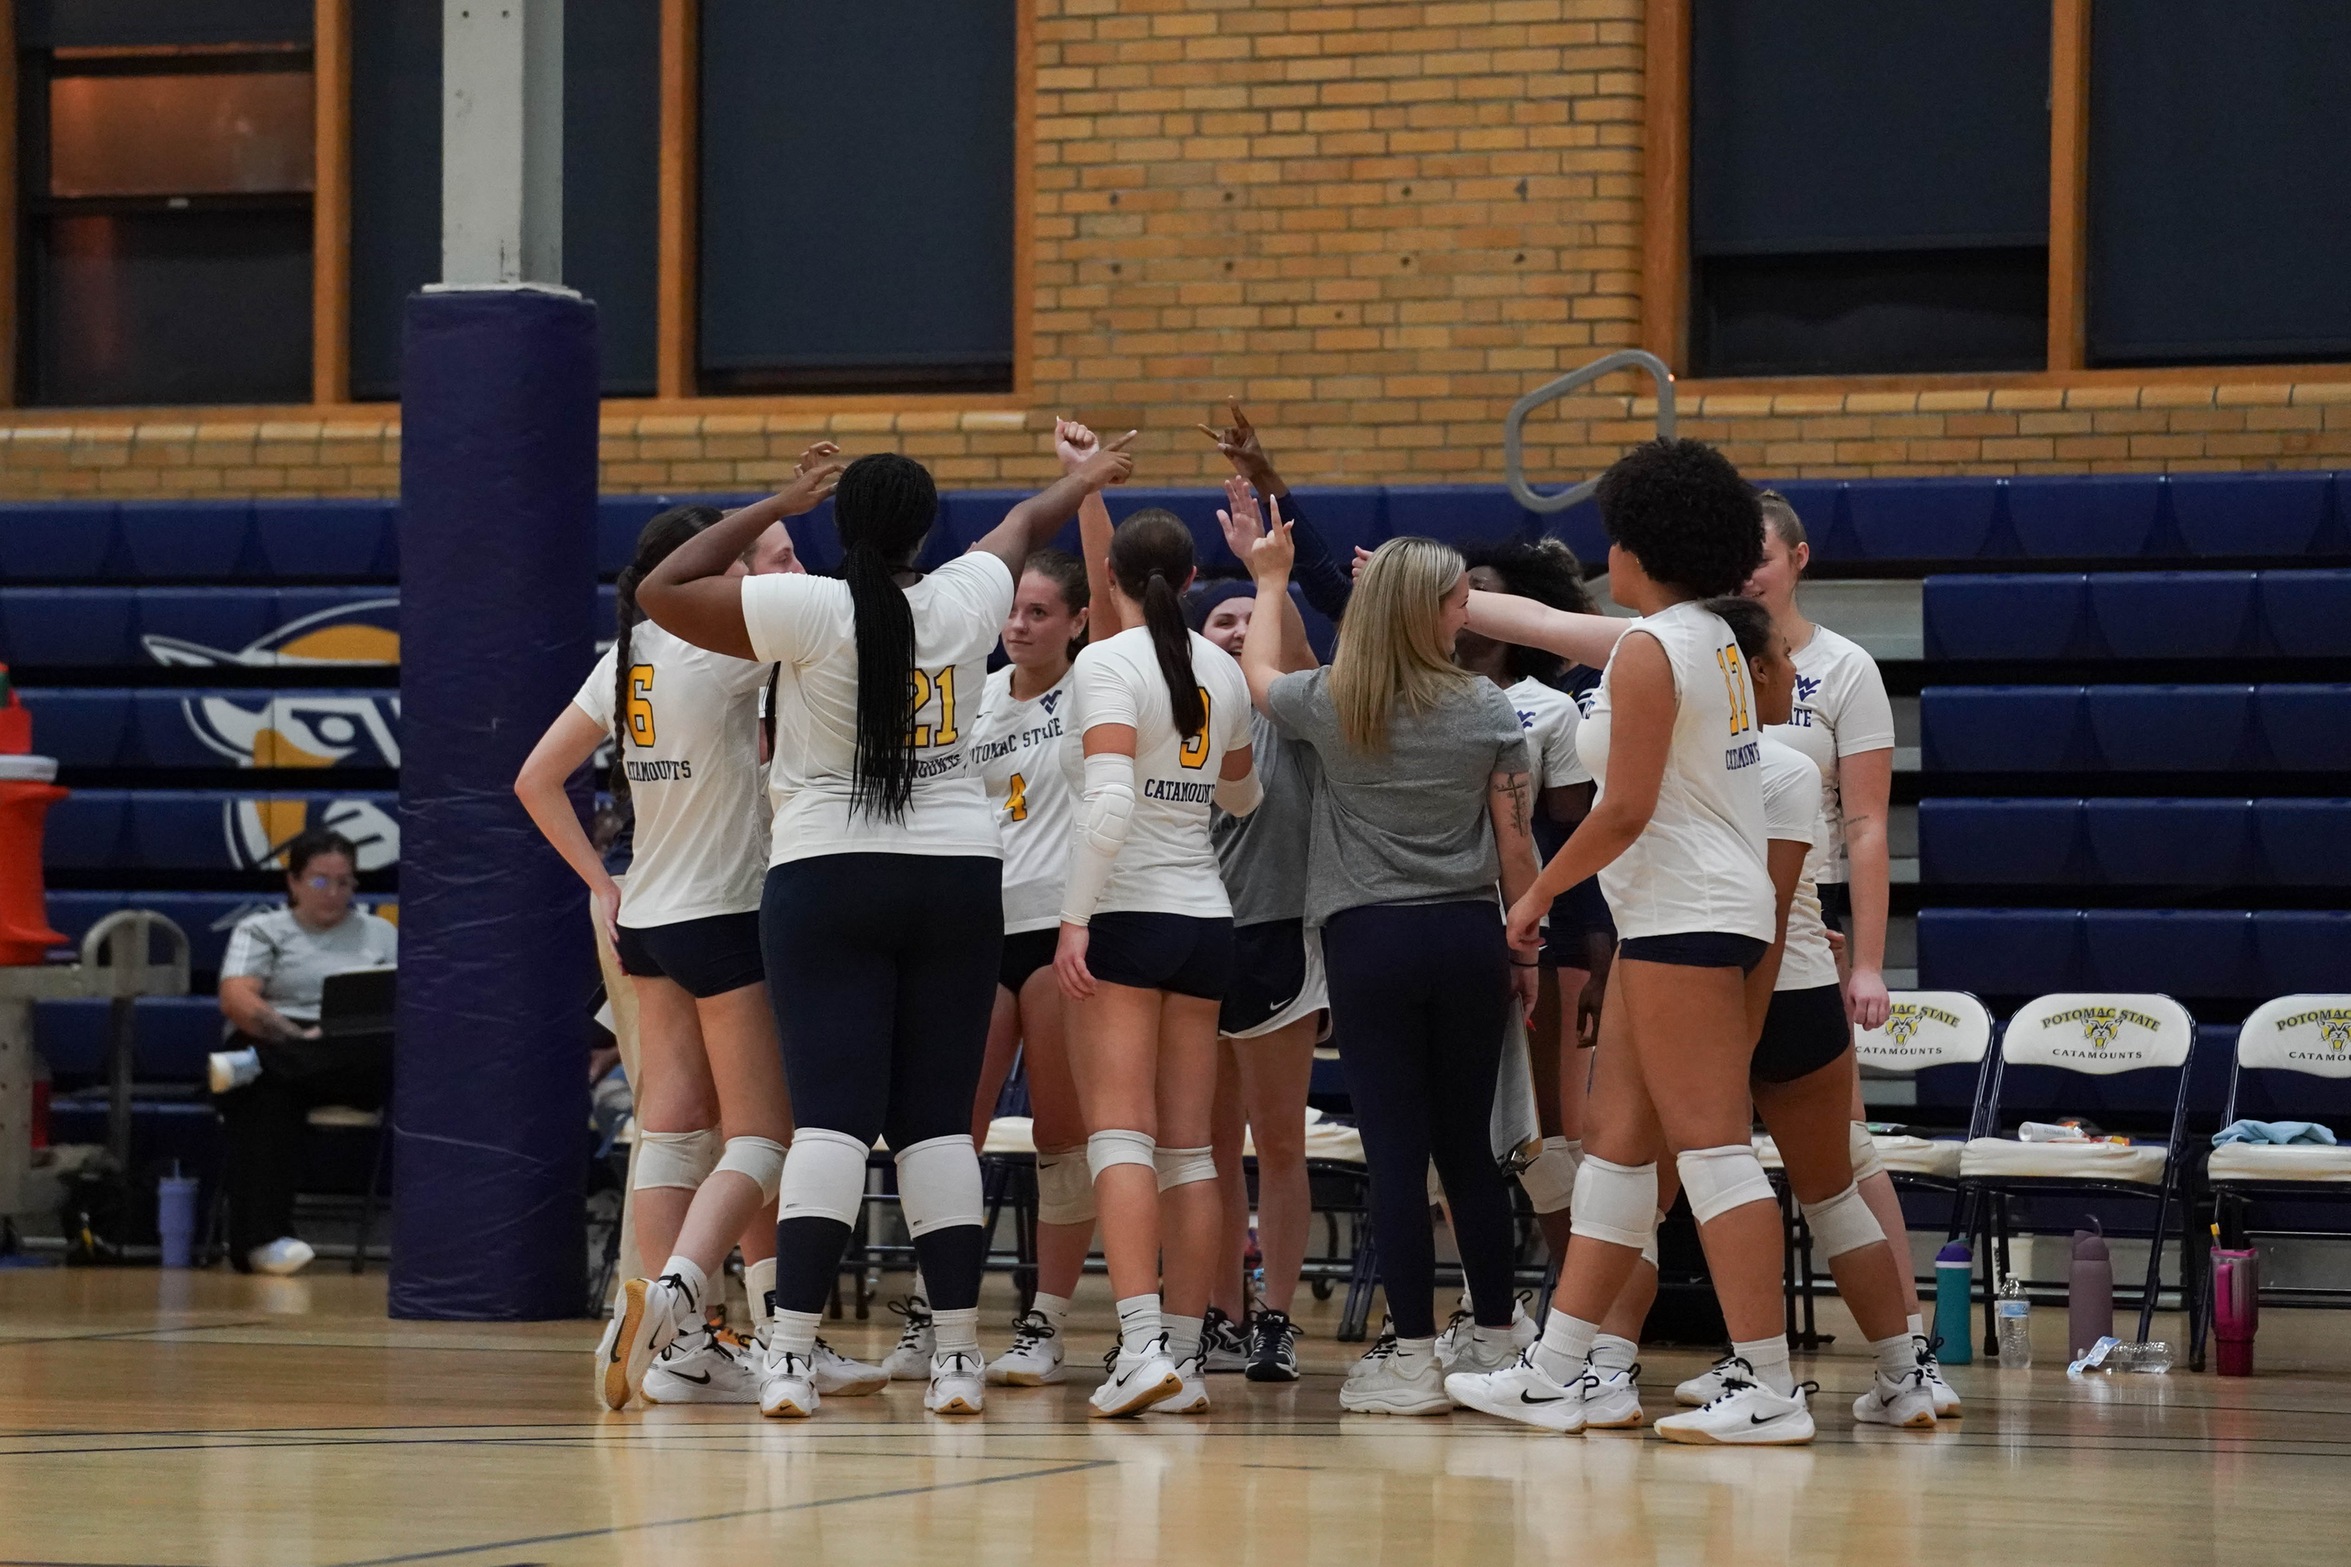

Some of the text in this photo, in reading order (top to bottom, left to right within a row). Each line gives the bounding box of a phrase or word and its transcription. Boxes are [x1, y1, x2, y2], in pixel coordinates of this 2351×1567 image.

[626, 664, 656, 748] 6
[903, 664, 958, 748] 21
[1003, 772, 1028, 822] 4
[1920, 1005, 1961, 1029] STATE
[2041, 1007, 2161, 1033] POTOMAC STATE
[1855, 1046, 1943, 1056] CATAMOUNTS
[2051, 1048, 2143, 1060] CATAMOUNTS
[2288, 1051, 2351, 1062] CATAMO
